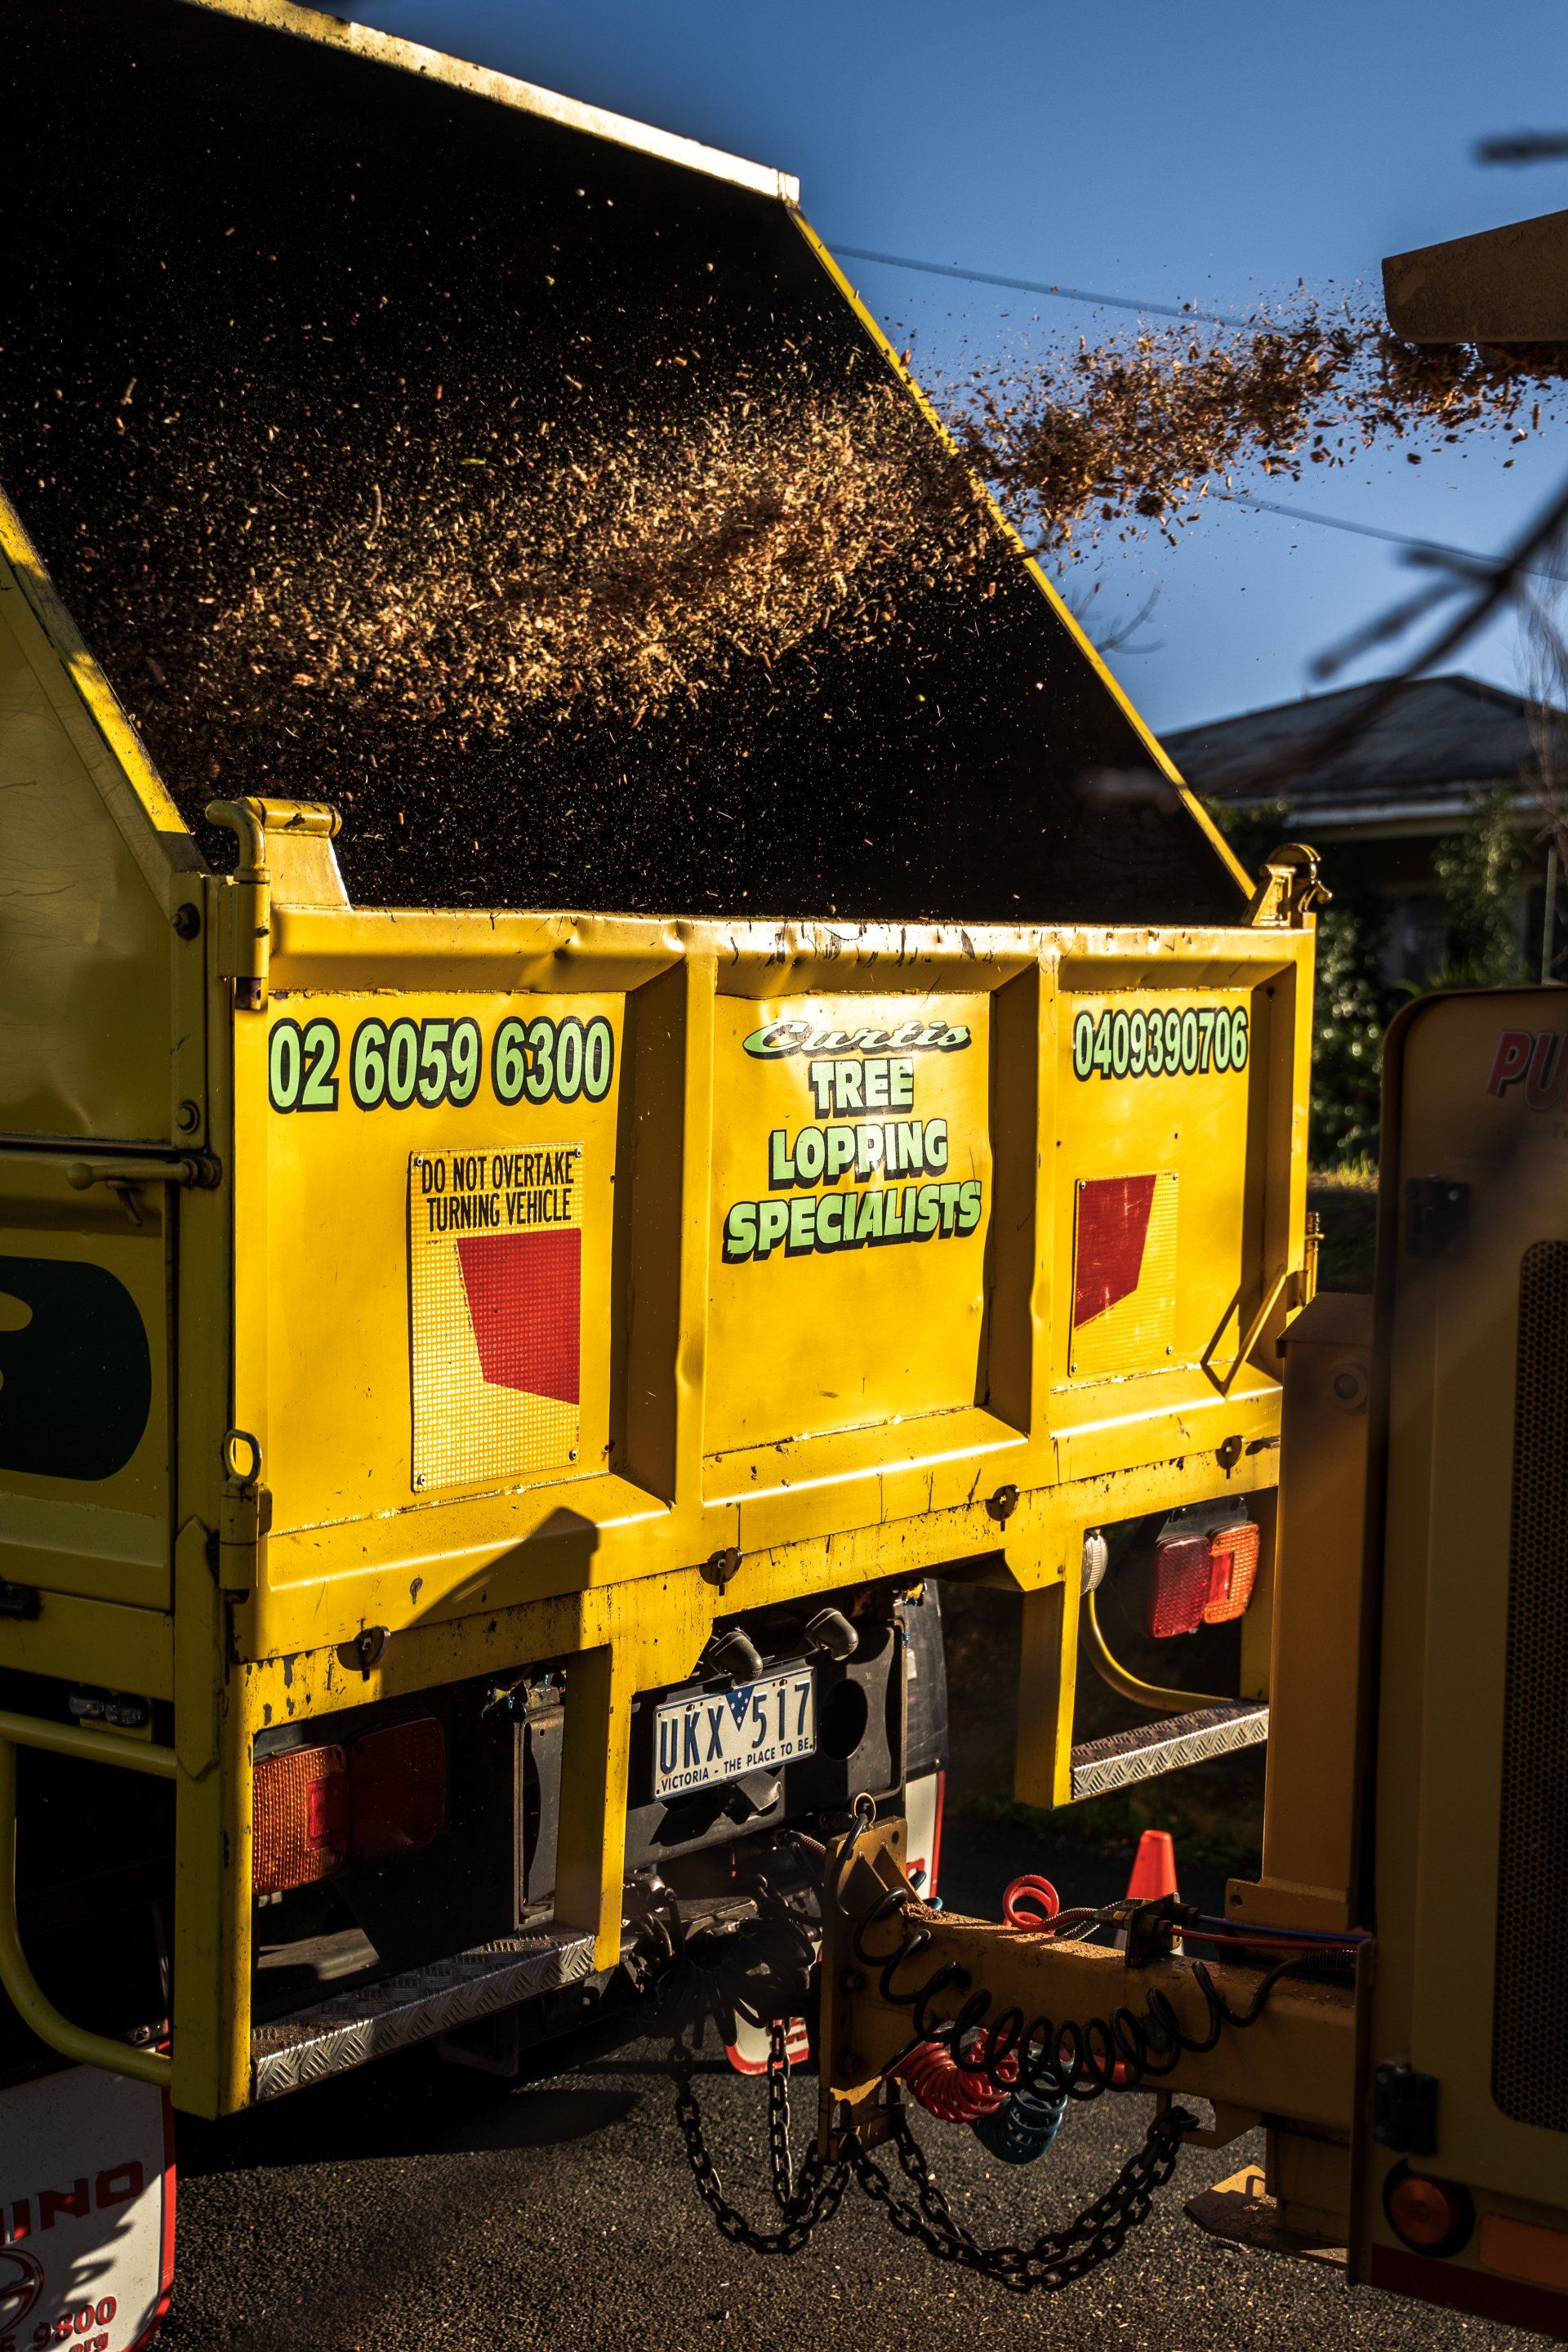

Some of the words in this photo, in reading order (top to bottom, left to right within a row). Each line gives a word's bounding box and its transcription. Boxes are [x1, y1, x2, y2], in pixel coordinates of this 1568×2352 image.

[269, 1018, 339, 1114] 02
[350, 1018, 482, 1111] 6059
[492, 1016, 614, 1105] 6300
[742, 1021, 972, 1060] Curtis
[1073, 1005, 1249, 1082] 0409390706
[1486, 1031, 1568, 1110] PU
[808, 1057, 914, 1120] TREE
[422, 1158, 446, 1194] DO
[453, 1156, 488, 1192] NOT
[492, 1151, 574, 1190] OVERTAKE
[768, 1119, 948, 1191] LOPPING
[426, 1193, 500, 1232] TURNING
[506, 1187, 572, 1225] VEHICLE
[722, 1181, 982, 1263] SPECIALISTS
[660, 1702, 724, 1775] UKX
[751, 1680, 810, 1748] 517
[662, 1767, 709, 1792] VICTORIA
[724, 1757, 742, 1774] THE
[746, 1747, 776, 1766] PLACE
[781, 1742, 793, 1757] TO
[0, 2161, 144, 2245] INO
[33, 2296, 117, 2350] 9800
